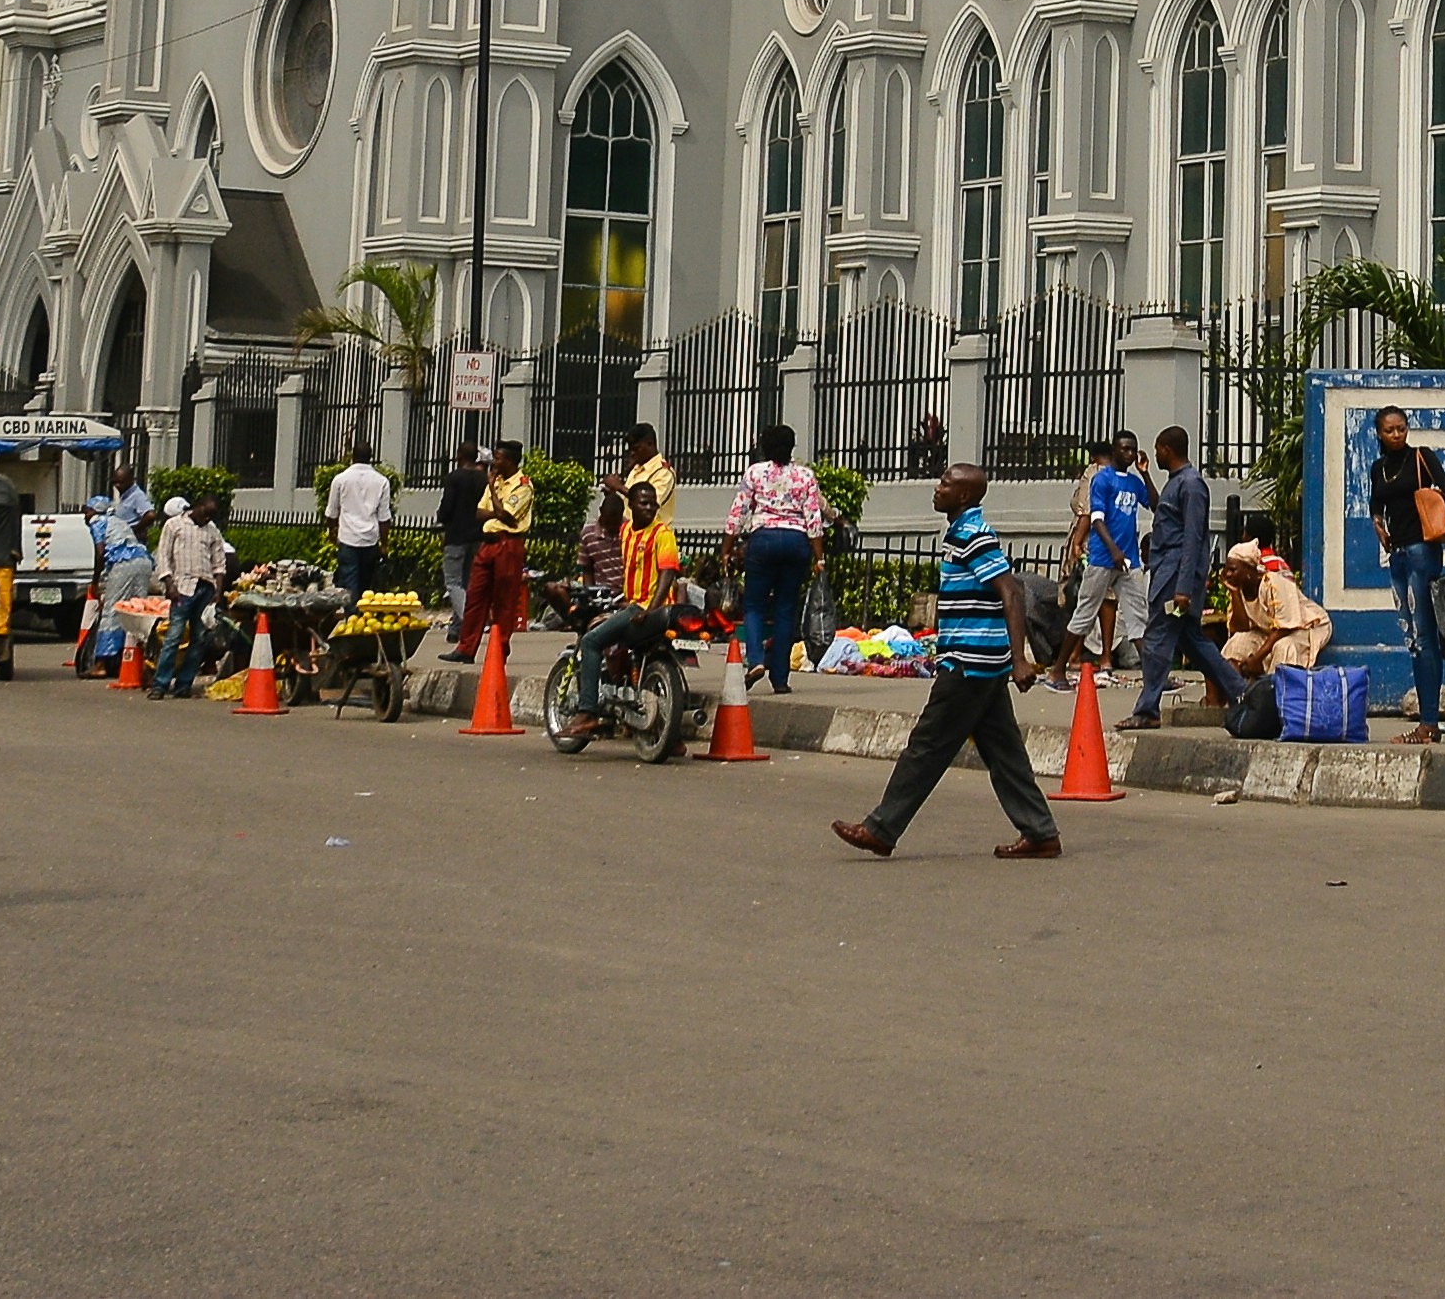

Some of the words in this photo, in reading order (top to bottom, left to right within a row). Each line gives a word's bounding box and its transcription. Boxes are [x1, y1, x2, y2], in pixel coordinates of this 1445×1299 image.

[467, 358, 480, 371] NO
[2, 420, 31, 435] CBD
[35, 420, 88, 435] MARINA
